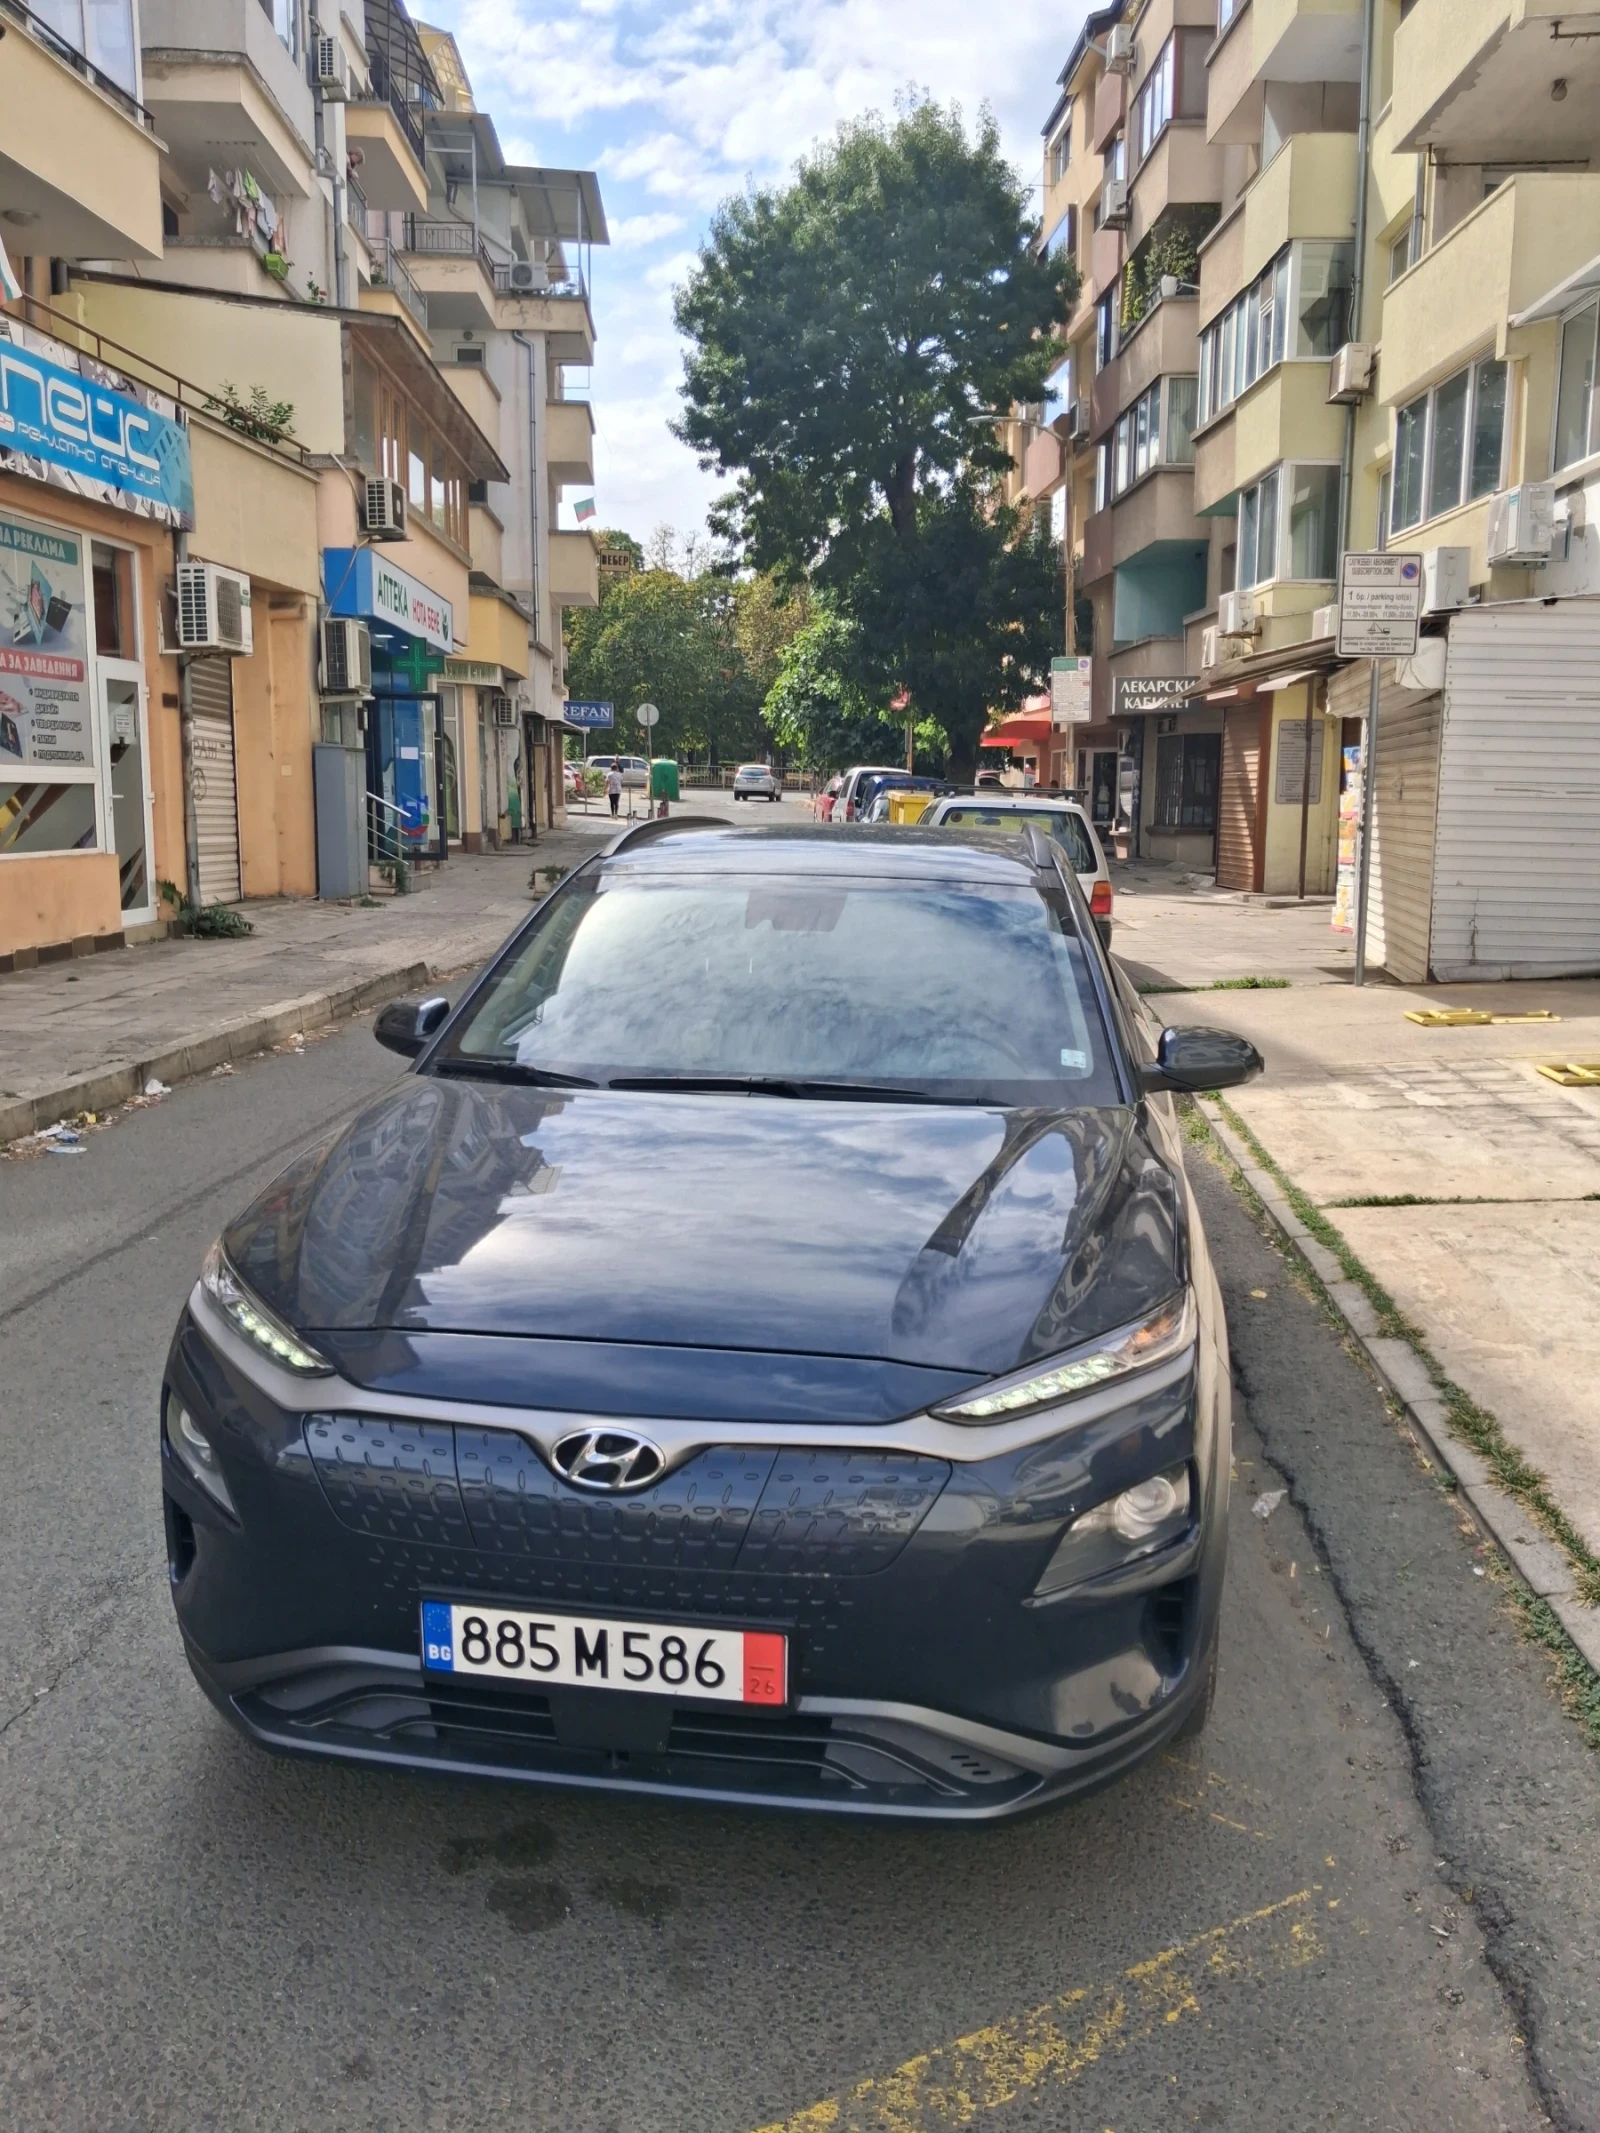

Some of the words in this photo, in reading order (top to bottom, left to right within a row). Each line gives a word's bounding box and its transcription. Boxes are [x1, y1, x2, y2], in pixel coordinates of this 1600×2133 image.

[13, 529, 66, 560] РЕКЛАМА
[377, 570, 409, 619] АПТЕКА
[412, 597, 427, 627] НОТА
[1348, 590, 1354, 601] 1
[1371, 592, 1394, 603] parking
[8, 653, 22, 669] ЗА
[23, 656, 78, 677] ЗАВЕДЕНИЯ
[428, 1644, 452, 1662] BG
[461, 1616, 561, 1673] 885
[574, 1627, 609, 1679] M
[622, 1631, 726, 1689] 586
[750, 1678, 775, 1695] 26
